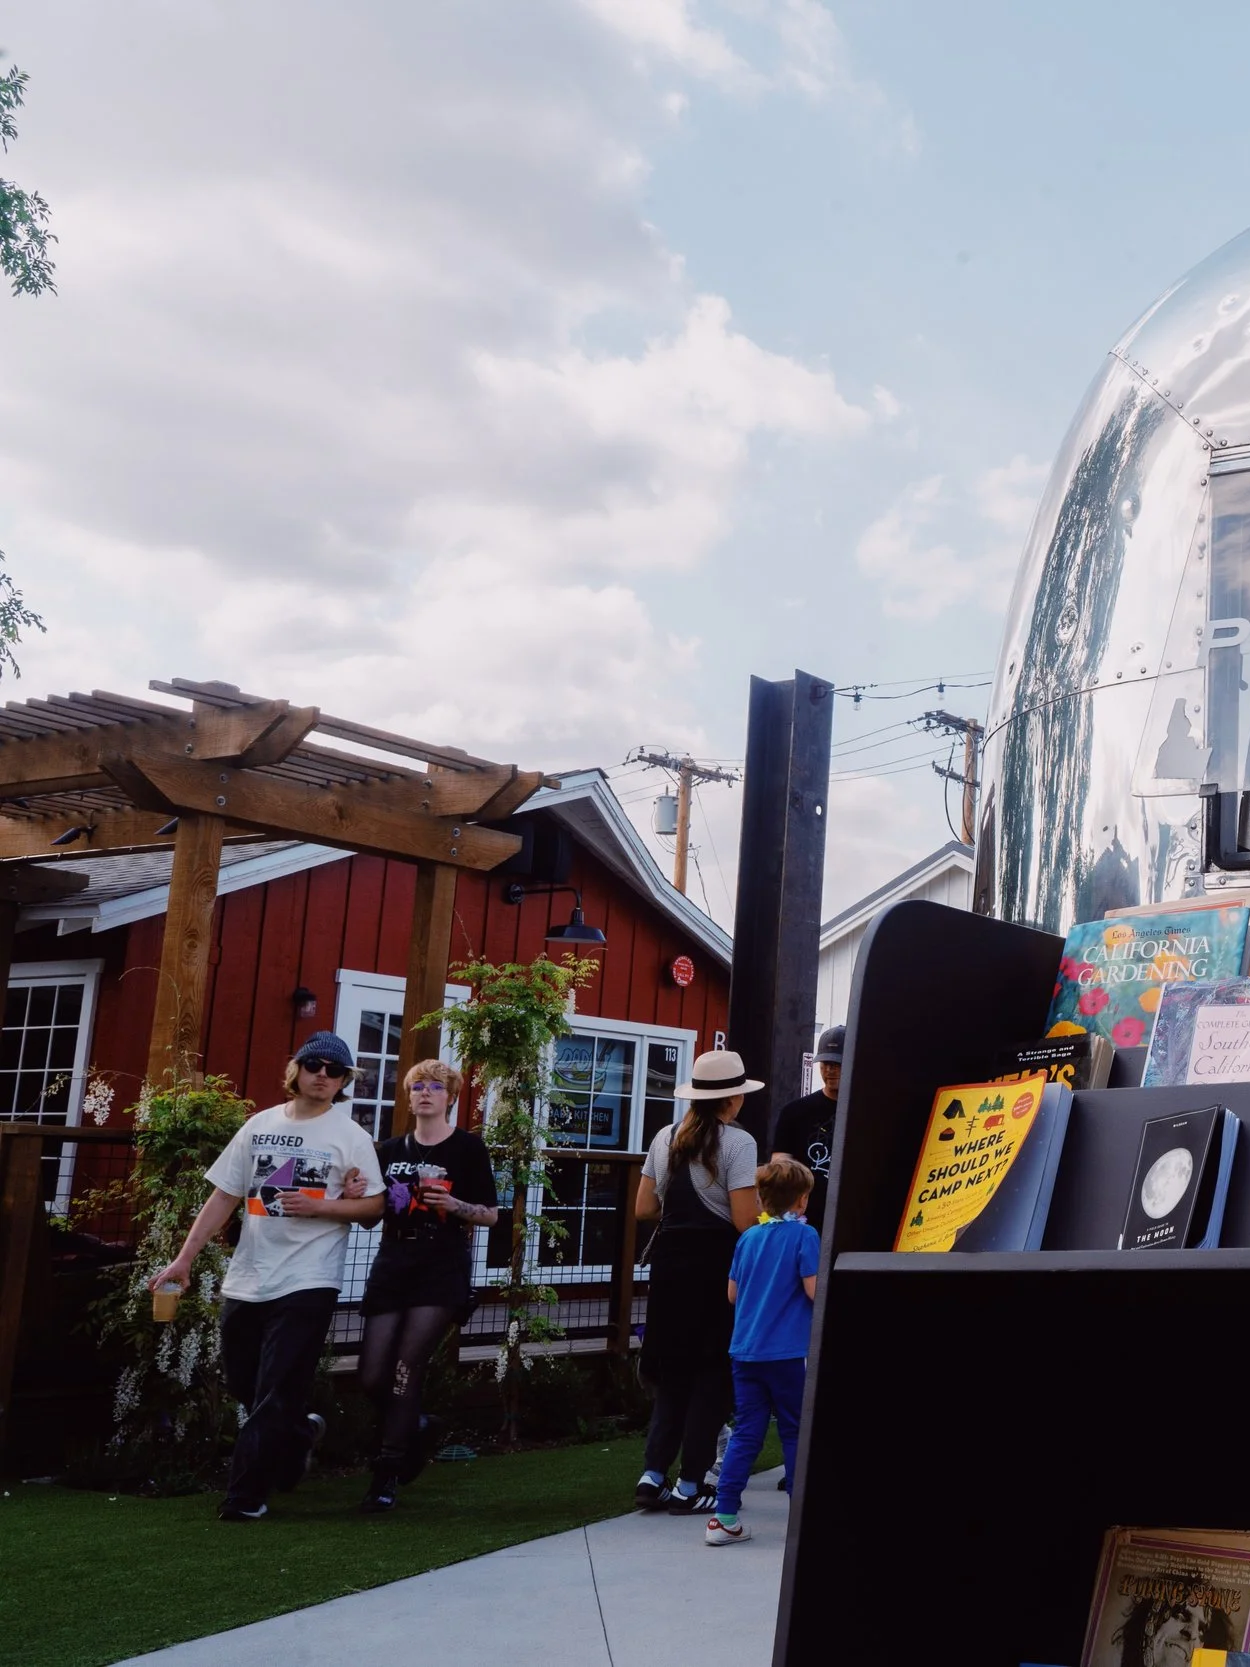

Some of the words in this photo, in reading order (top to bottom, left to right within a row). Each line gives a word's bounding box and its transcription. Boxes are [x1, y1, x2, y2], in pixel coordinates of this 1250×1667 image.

[1112, 929, 1128, 940] Los
[1129, 927, 1162, 939] Angeles
[1164, 926, 1191, 936] Times
[1083, 935, 1210, 964] CALIFORNIA
[1077, 958, 1209, 986] GARDENING
[1197, 1020, 1240, 1029] COMPLETE
[665, 1047, 677, 1062] 113
[1018, 1054, 1049, 1062] Terrible
[1051, 1051, 1072, 1059] Saga
[1026, 1048, 1057, 1056] Strange
[252, 1134, 303, 1147] REFUSED
[954, 1130, 1006, 1158] WHERE
[927, 1153, 989, 1183] SHOULD
[994, 1141, 1015, 1160] WE
[918, 1180, 962, 1204] CAMP
[965, 1158, 1009, 1190] NEXT?
[1137, 1233, 1151, 1243] THE
[1154, 1226, 1175, 1239] MOON
[1119, 1574, 1185, 1607] ROLLING
[1188, 1582, 1242, 1615] STONE
